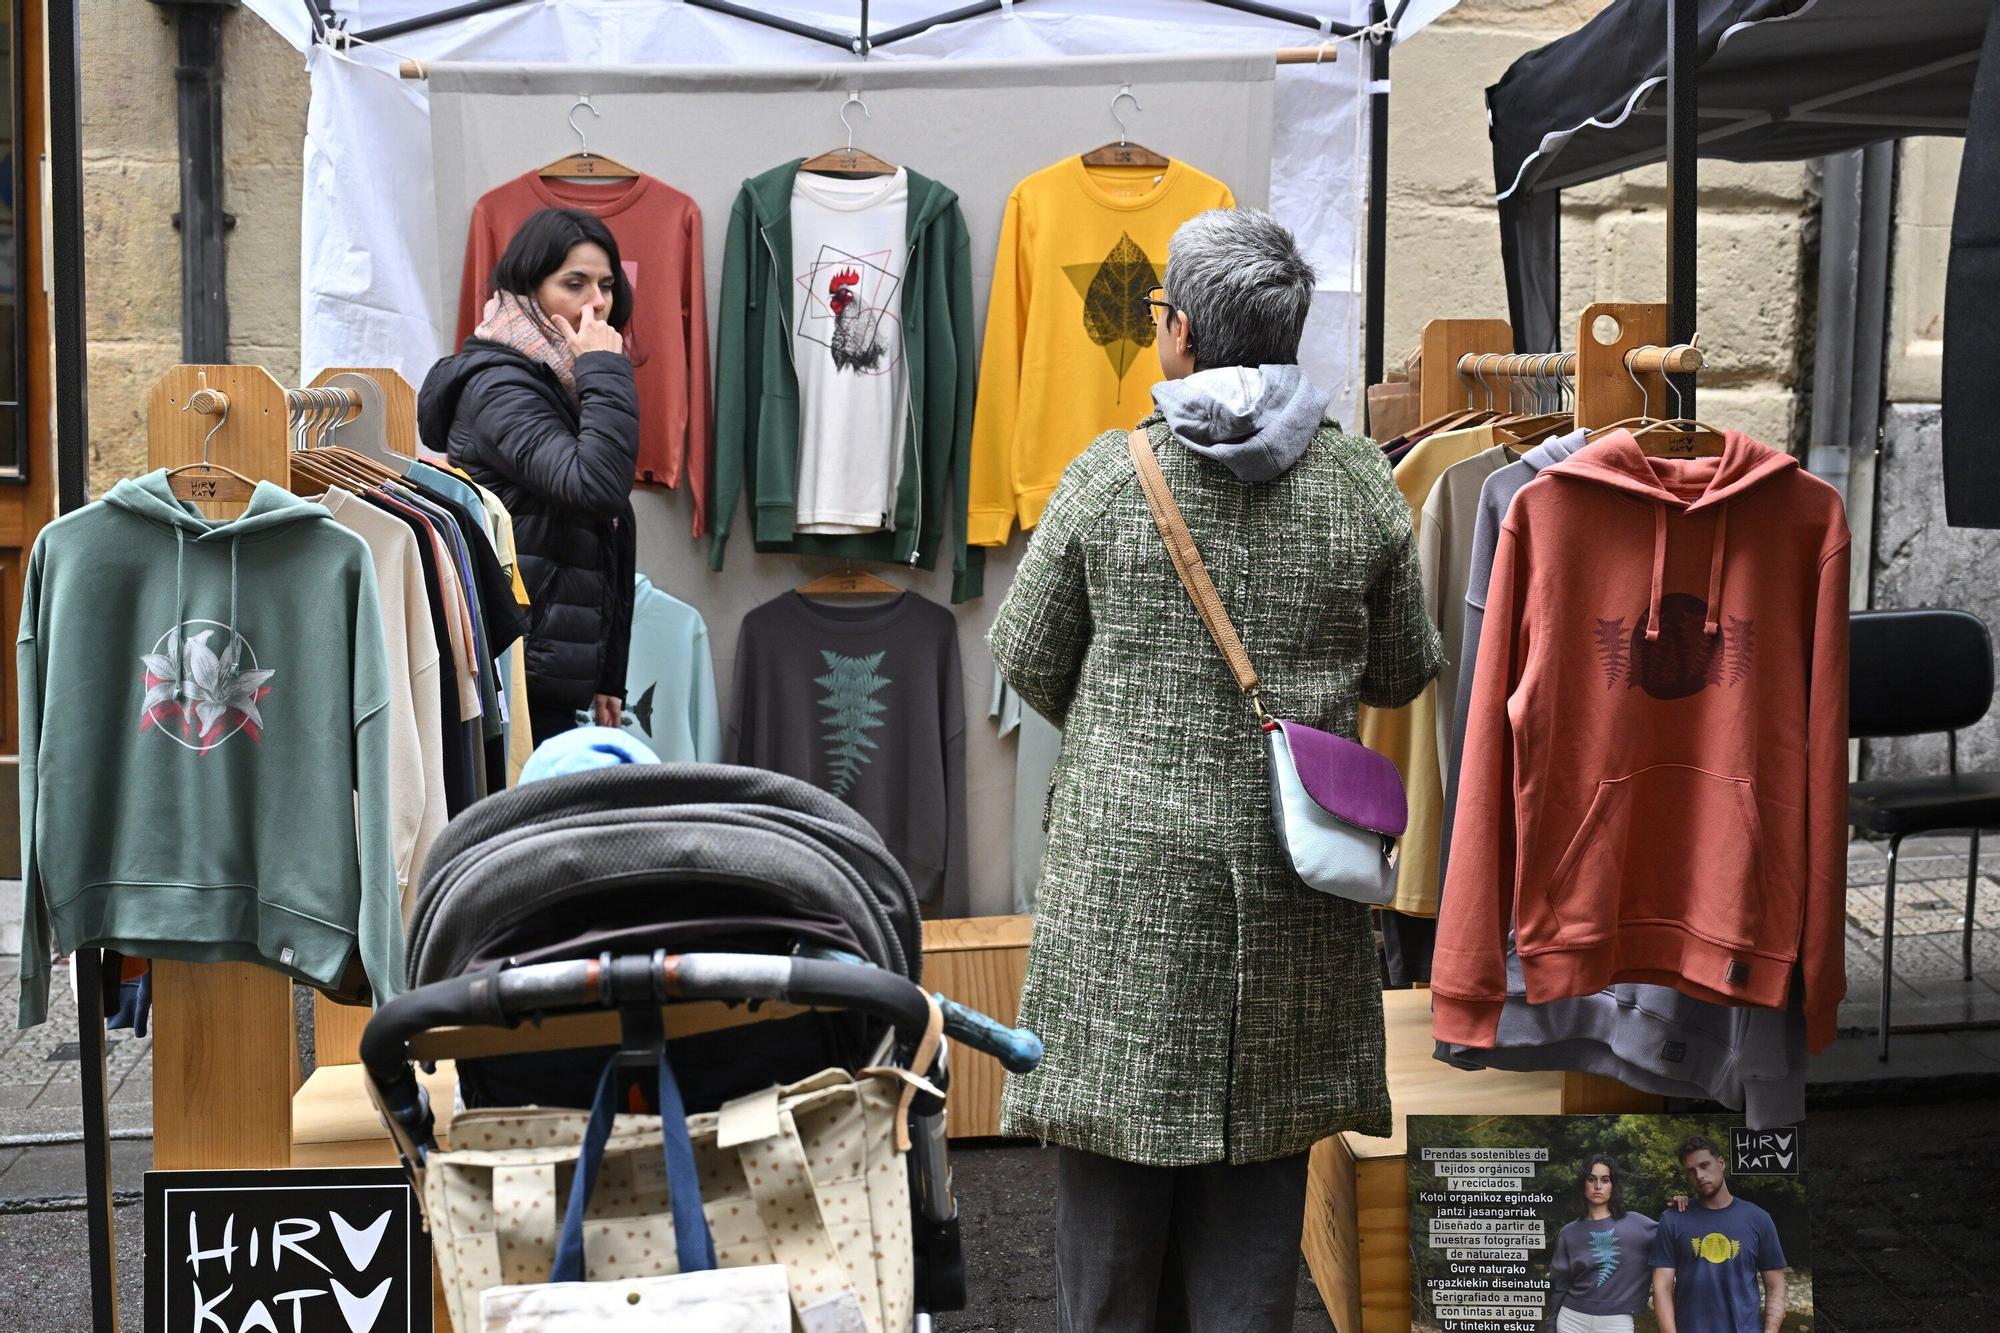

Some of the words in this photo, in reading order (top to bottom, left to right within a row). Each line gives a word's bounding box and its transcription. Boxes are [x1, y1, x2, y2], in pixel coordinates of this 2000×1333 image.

[1424, 1149, 1467, 1160] Prendas
[1471, 1149, 1531, 1160] sostenibles
[1534, 1150, 1546, 1160] de
[1440, 1163, 1475, 1175] tejidos
[1479, 1164, 1531, 1175] orgánicos
[1453, 1180, 1459, 1189] y
[1462, 1179, 1518, 1188] reciclados.
[1420, 1192, 1447, 1202] Kotoi
[1449, 1192, 1502, 1204] organikoz
[1504, 1193, 1553, 1204] egindako
[1437, 1206, 1466, 1217] jantzi
[1469, 1206, 1536, 1218] jasangarriak
[1434, 1220, 1482, 1230] Diseñado
[1495, 1222, 1524, 1232] partir
[1528, 1221, 1540, 1231] de
[1435, 1235, 1480, 1245] nuestras
[1484, 1235, 1540, 1247] fotografías
[1451, 1249, 1463, 1259] de
[1466, 1249, 1525, 1260] naturaleza.
[1450, 1263, 1476, 1274] Gure
[1479, 1263, 1526, 1274] naturako
[1427, 1277, 1489, 1290] argazkiekin
[1492, 1278, 1551, 1289] diseinatuta
[1435, 1291, 1500, 1303] Serigrafiado
[1513, 1295, 1543, 1303] mano
[1441, 1307, 1459, 1316] con
[1463, 1306, 1492, 1317] tintas
[1496, 1306, 1505, 1317] al
[1508, 1309, 1538, 1319] agua.
[1444, 1320, 1457, 1331] Ur
[1460, 1320, 1501, 1331] tintekin
[1503, 1321, 1536, 1332] eskuz
